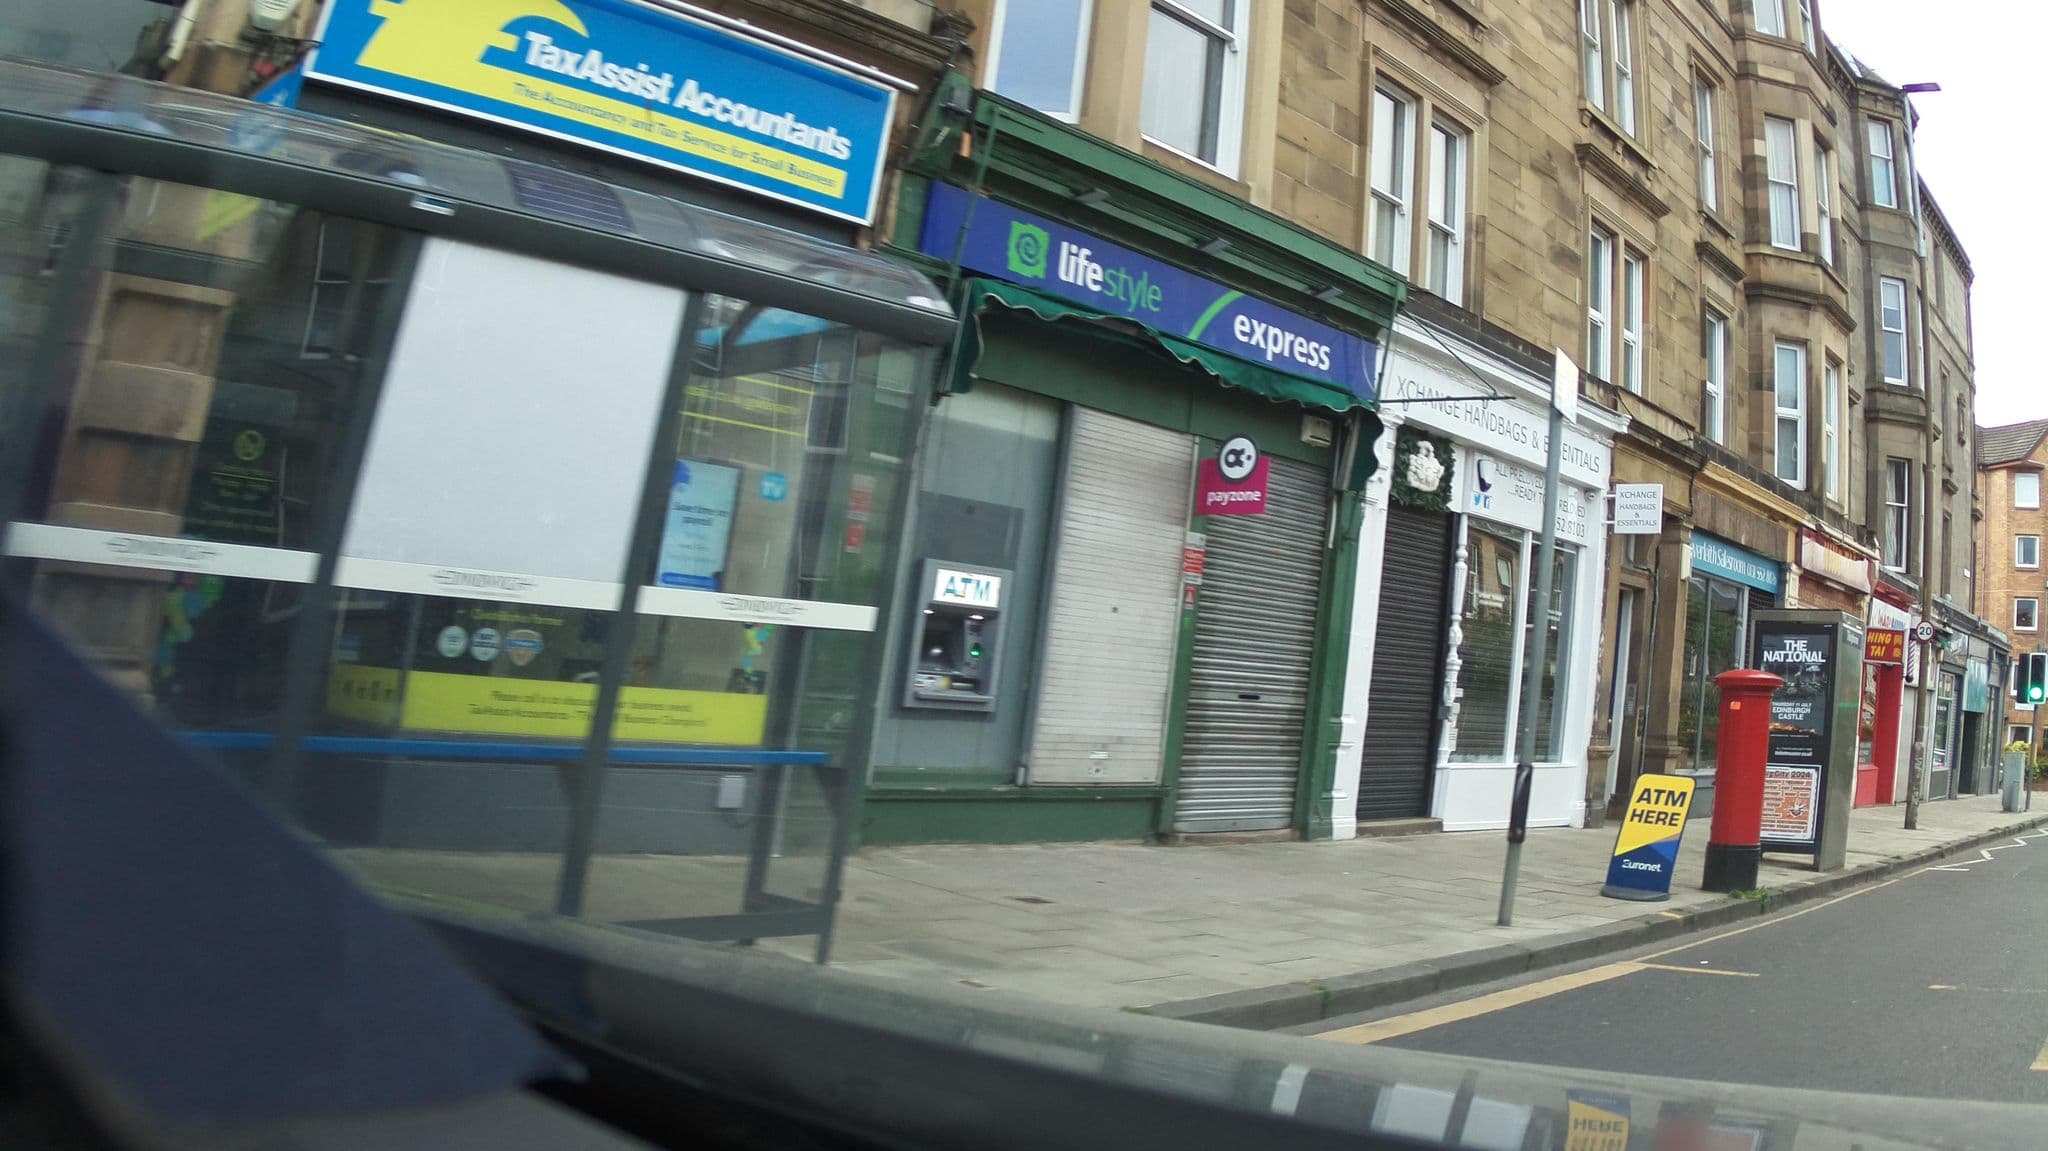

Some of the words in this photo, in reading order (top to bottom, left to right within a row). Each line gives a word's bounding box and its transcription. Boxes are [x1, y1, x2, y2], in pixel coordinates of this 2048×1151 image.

[525, 30, 674, 105] TaxAssist
[672, 78, 852, 160] Accountants
[1058, 241, 1162, 313] lifestyle
[1233, 314, 1332, 371] express
[1397, 376, 1460, 419] XCHANGE
[1464, 400, 1528, 445] HANDBAGS
[1531, 429, 1540, 450] &
[1543, 434, 1601, 474] EENTIALS
[1205, 490, 1262, 506] payzone
[1619, 491, 1657, 500] XCHANGE
[1619, 503, 1657, 511] HANDBAGS
[1616, 519, 1657, 528] ESSENTIALS
[943, 575, 991, 602] ATM
[1919, 626, 1932, 636] 20
[1867, 632, 1892, 645] HING
[1783, 640, 1808, 651] THE
[1871, 646, 1886, 657] TAI
[1763, 650, 1827, 663] NATIONAL
[1772, 706, 1811, 714] EDINBURGH
[1636, 788, 1688, 808] ATM
[1630, 809, 1681, 827] HERE
[1621, 859, 1663, 873] Euronet
